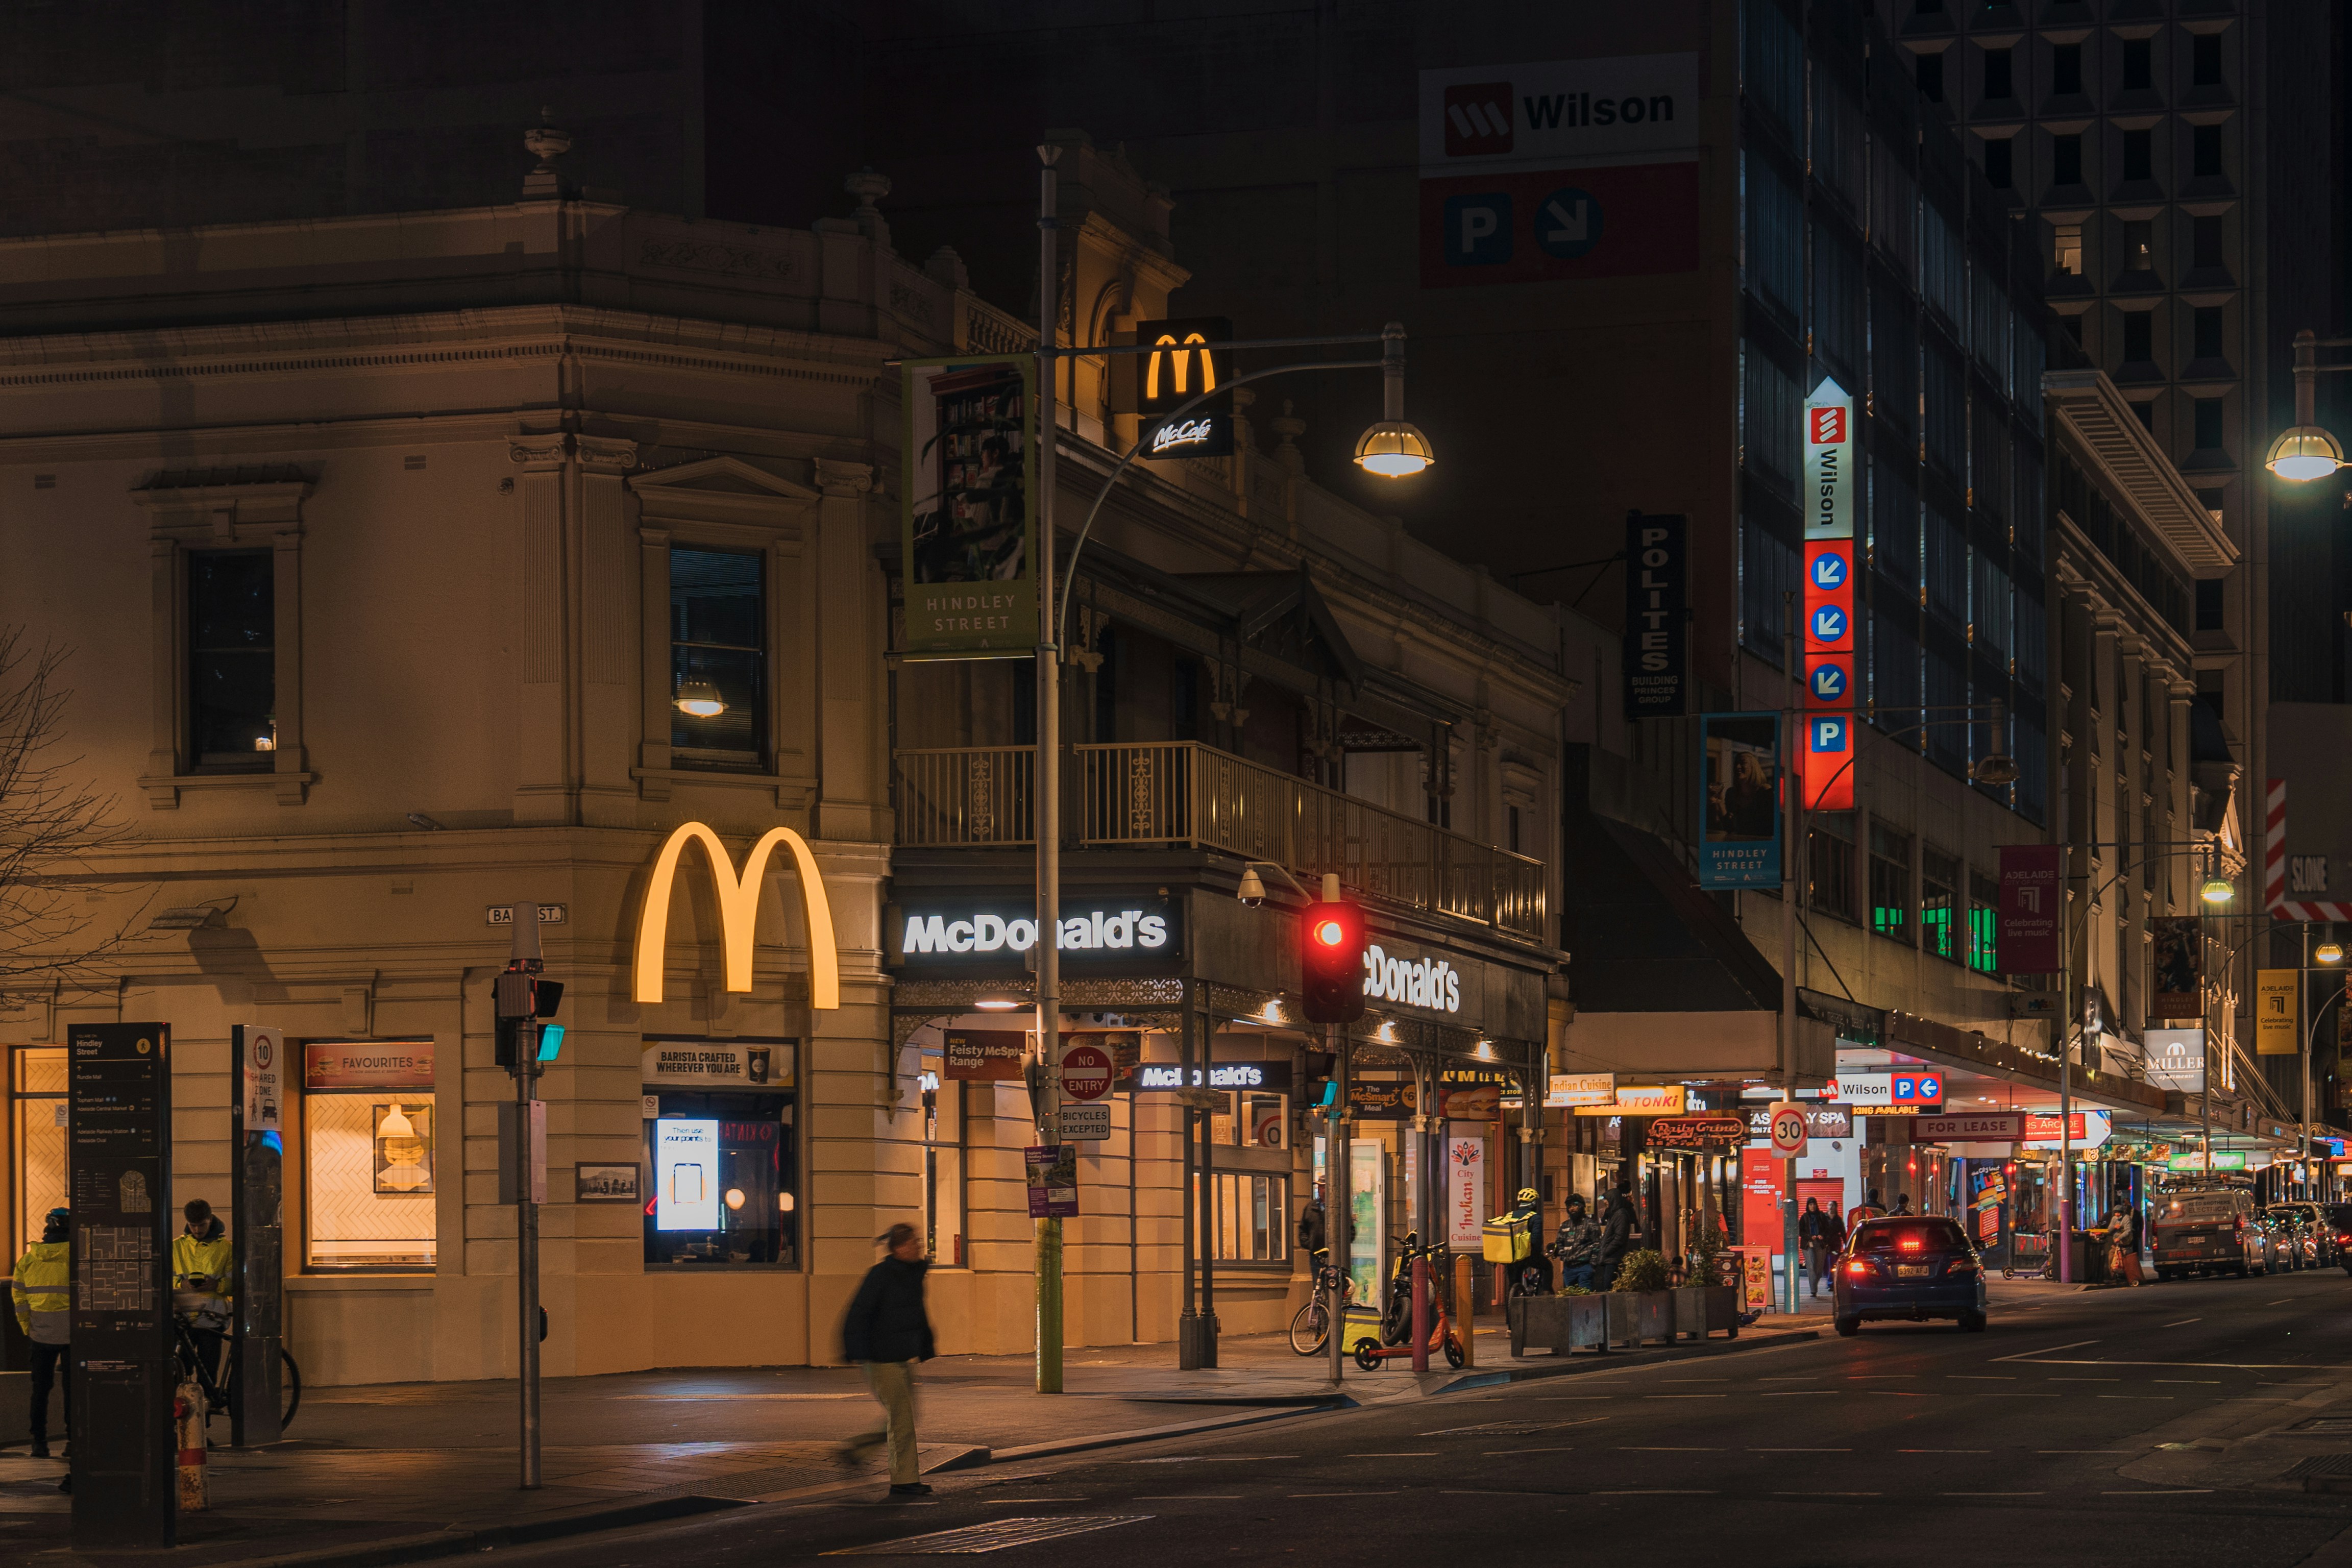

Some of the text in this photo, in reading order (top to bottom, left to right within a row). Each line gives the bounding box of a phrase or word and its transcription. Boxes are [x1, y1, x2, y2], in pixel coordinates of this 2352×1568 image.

[1524, 92, 1674, 130] Wilson
[1461, 207, 1498, 253] P
[1153, 419, 1211, 448] McCafé
[1821, 448, 1838, 525] Wilson
[926, 595, 1015, 611] HINDLEY
[1641, 528, 1669, 671] POLITES
[935, 616, 1009, 631] STREET
[1632, 675, 1678, 686] BUILDING
[1633, 687, 1676, 695] PRINCES
[1638, 695, 1671, 704] GROUP
[1821, 722, 1839, 746] P
[1712, 849, 1767, 858] HINDLEY
[1717, 861, 1763, 870] STREET
[2005, 871, 2054, 879] ADELAIDE
[539, 908, 558, 920] ST.
[2004, 919, 2053, 928] Celebrating
[2008, 928, 2050, 937] live music
[77, 1040, 103, 1048] Hindley
[258, 1045, 268, 1060] 10
[950, 1044, 984, 1057] Feisty
[343, 1057, 413, 1069] FAVOURITES
[661, 1051, 736, 1063] BARISTA CRAFTED
[949, 1056, 984, 1068] Range
[1078, 1056, 1094, 1066] NO
[656, 1062, 703, 1073] WHEREVER
[706, 1063, 722, 1073] YOU
[724, 1064, 741, 1074] ARE
[255, 1086, 272, 1096] ZONE
[1069, 1080, 1105, 1091] ENTRY
[1550, 1079, 1612, 1091] Indian Cuisine
[1843, 1081, 1911, 1095] Wilson P
[1351, 1092, 1395, 1101] McSmart
[1063, 1112, 1107, 1120] BICYCLES
[1852, 1106, 1920, 1115] KING AVAILABLE
[1819, 1112, 1846, 1124] SPA
[1063, 1125, 1107, 1133] EXCEPTED
[1696, 1122, 1739, 1133] Grind
[1778, 1121, 1801, 1139] 30
[1927, 1121, 2007, 1132] FOR LEASE
[1457, 1170, 1474, 1179] City
[1459, 1181, 1475, 1230] Indian
